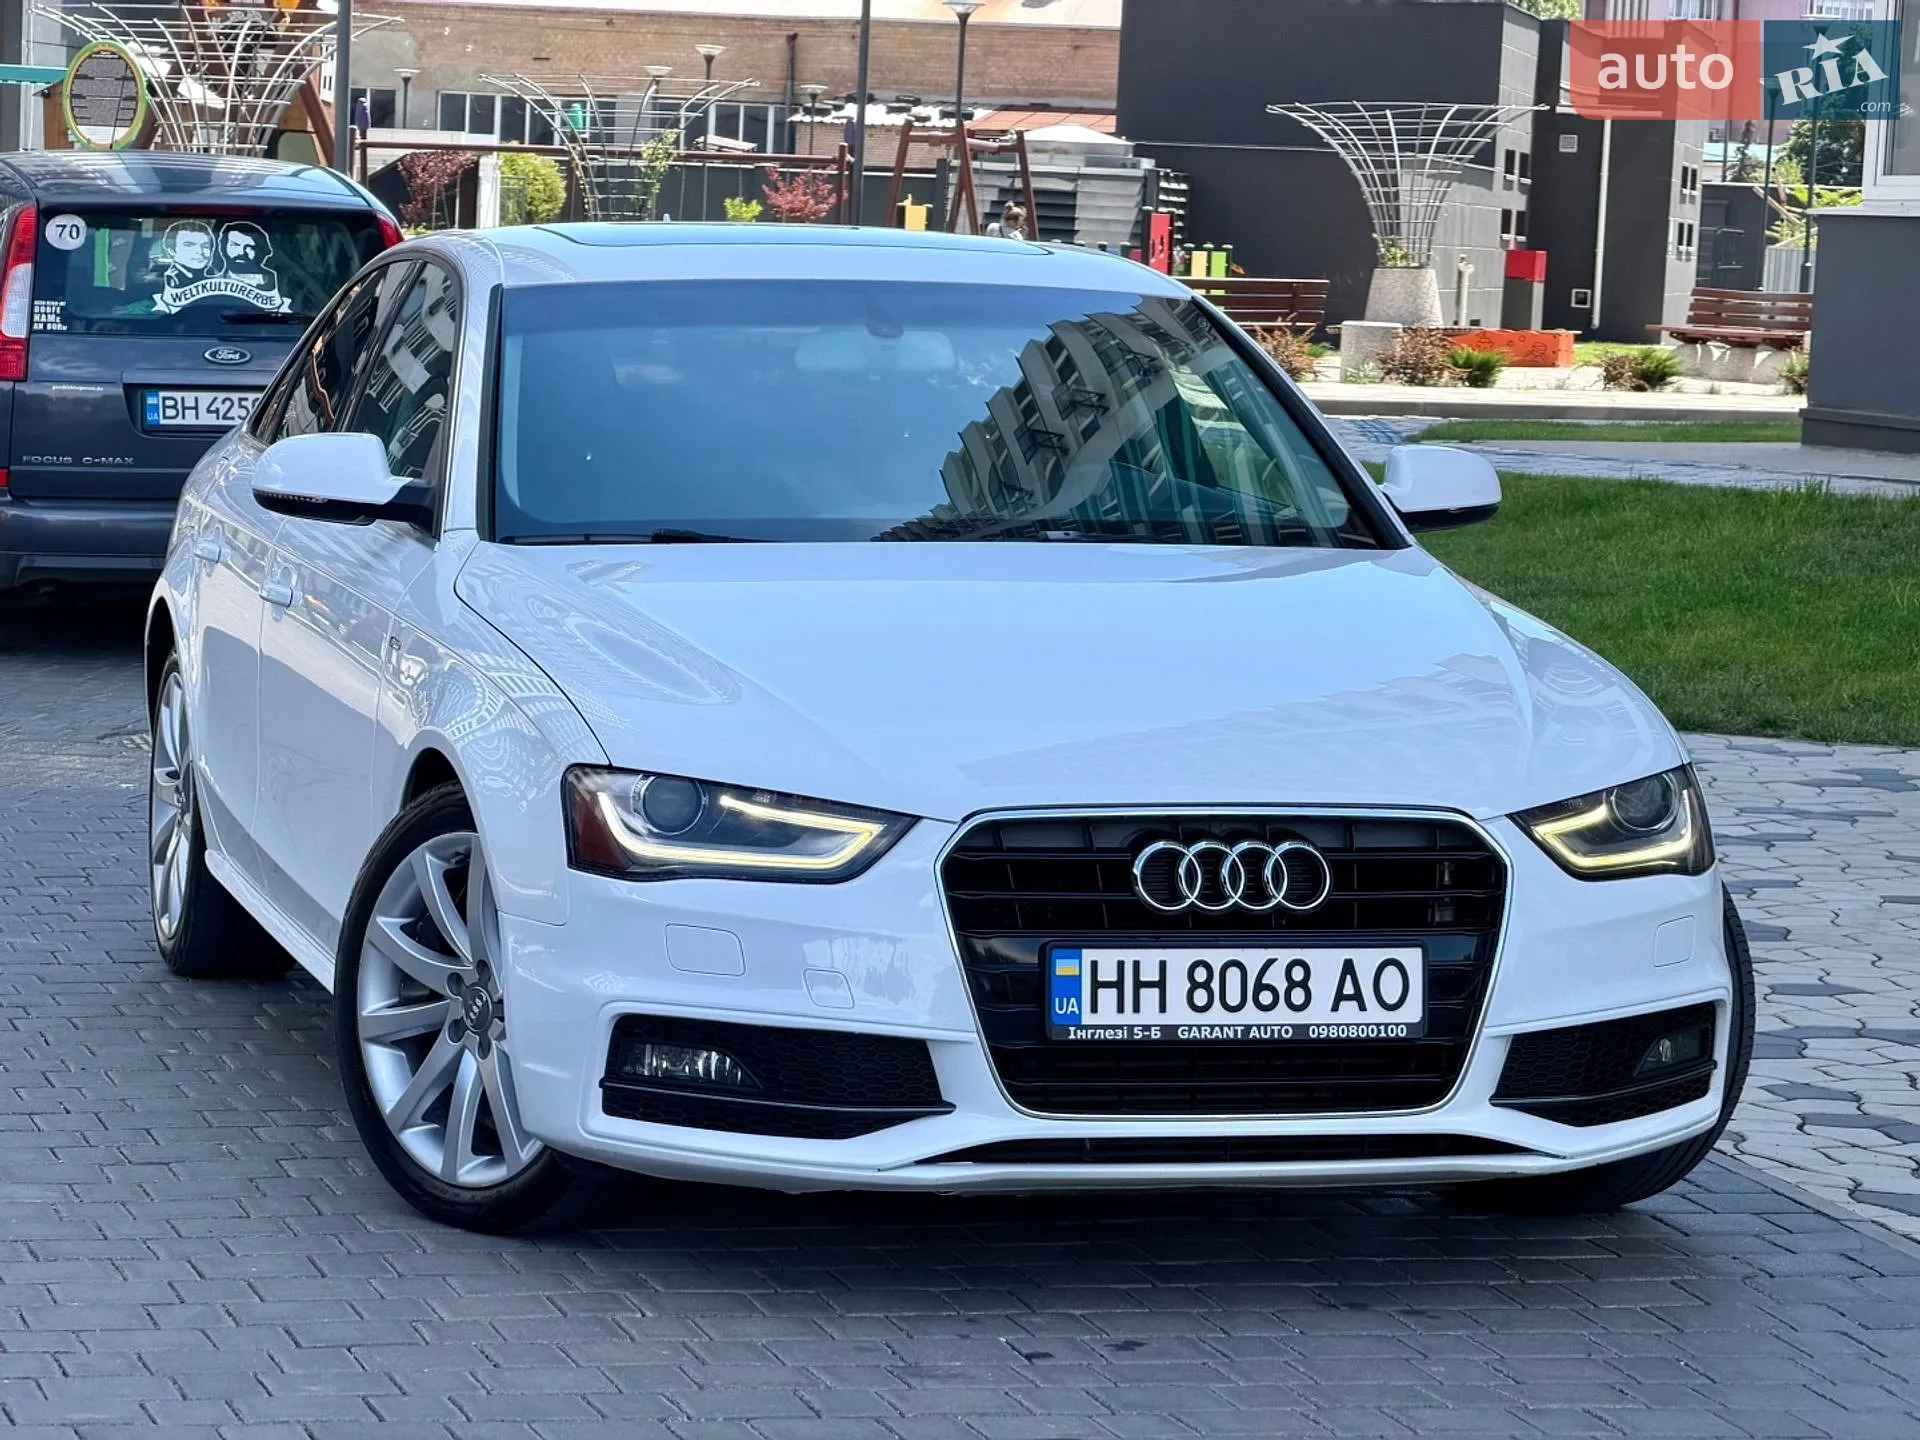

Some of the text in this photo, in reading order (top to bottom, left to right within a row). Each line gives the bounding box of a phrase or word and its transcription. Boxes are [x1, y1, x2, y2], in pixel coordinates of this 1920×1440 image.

[55, 224, 80, 240] 70
[171, 281, 277, 307] WELTKULTURERBE
[162, 396, 199, 420] BH
[22, 456, 73, 464] FOCUS
[1090, 958, 1410, 1014] HH 8068 AO
[1055, 998, 1079, 1014] UA
[1068, 1026, 1161, 1039] Інглезі 5-Б
[1178, 1025, 1407, 1039] GARANT AUTO 0980800100
